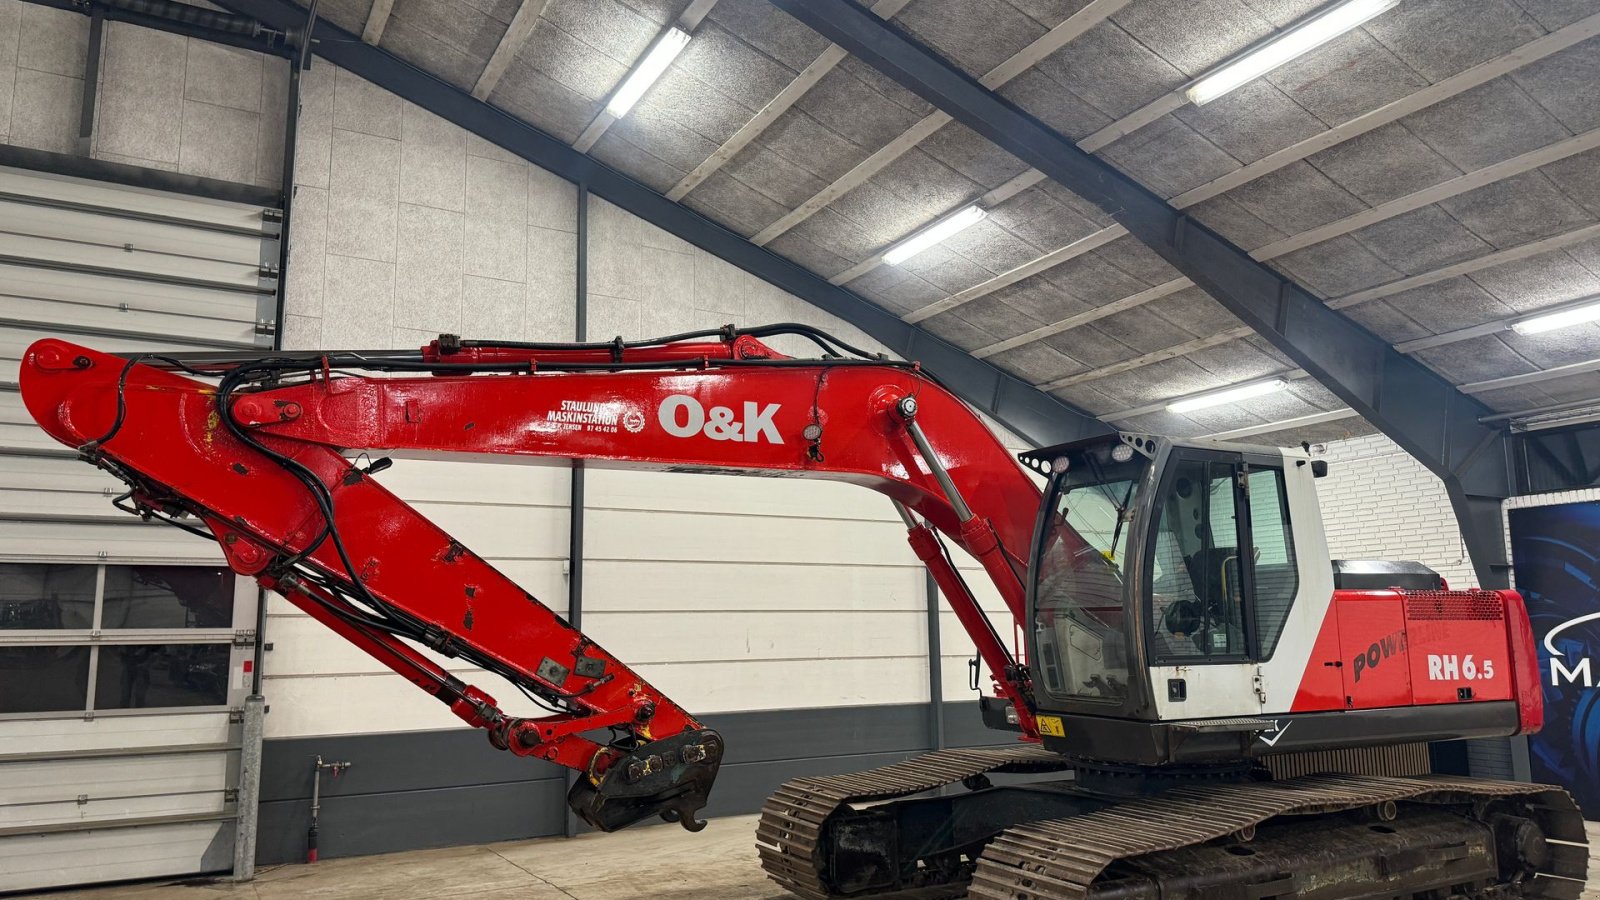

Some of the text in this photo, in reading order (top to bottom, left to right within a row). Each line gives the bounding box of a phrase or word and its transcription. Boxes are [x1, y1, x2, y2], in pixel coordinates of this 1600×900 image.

[547, 410, 618, 425] MASKINSTATION
[603, 425, 610, 433] 42
[658, 394, 785, 444] O&K
[1427, 654, 1494, 680] RH 6.5
[1550, 657, 1600, 687] M
